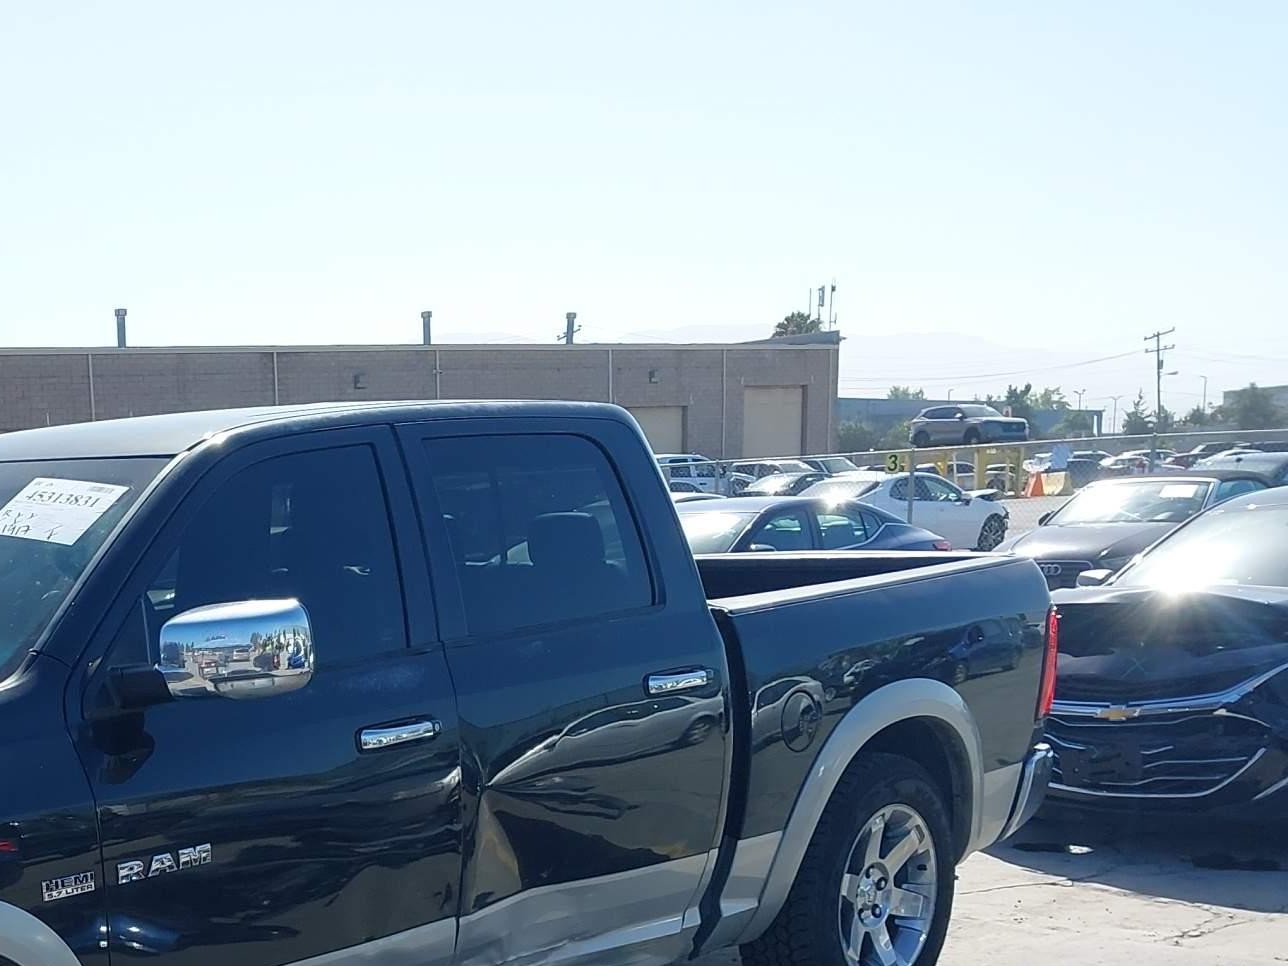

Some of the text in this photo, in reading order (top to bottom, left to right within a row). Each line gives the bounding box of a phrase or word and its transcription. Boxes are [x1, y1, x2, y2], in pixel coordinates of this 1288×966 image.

[25, 490, 101, 507] 45313831
[117, 843, 212, 885] RAM
[43, 872, 94, 893] HEMI
[46, 884, 93, 899] 5.7 LITER
